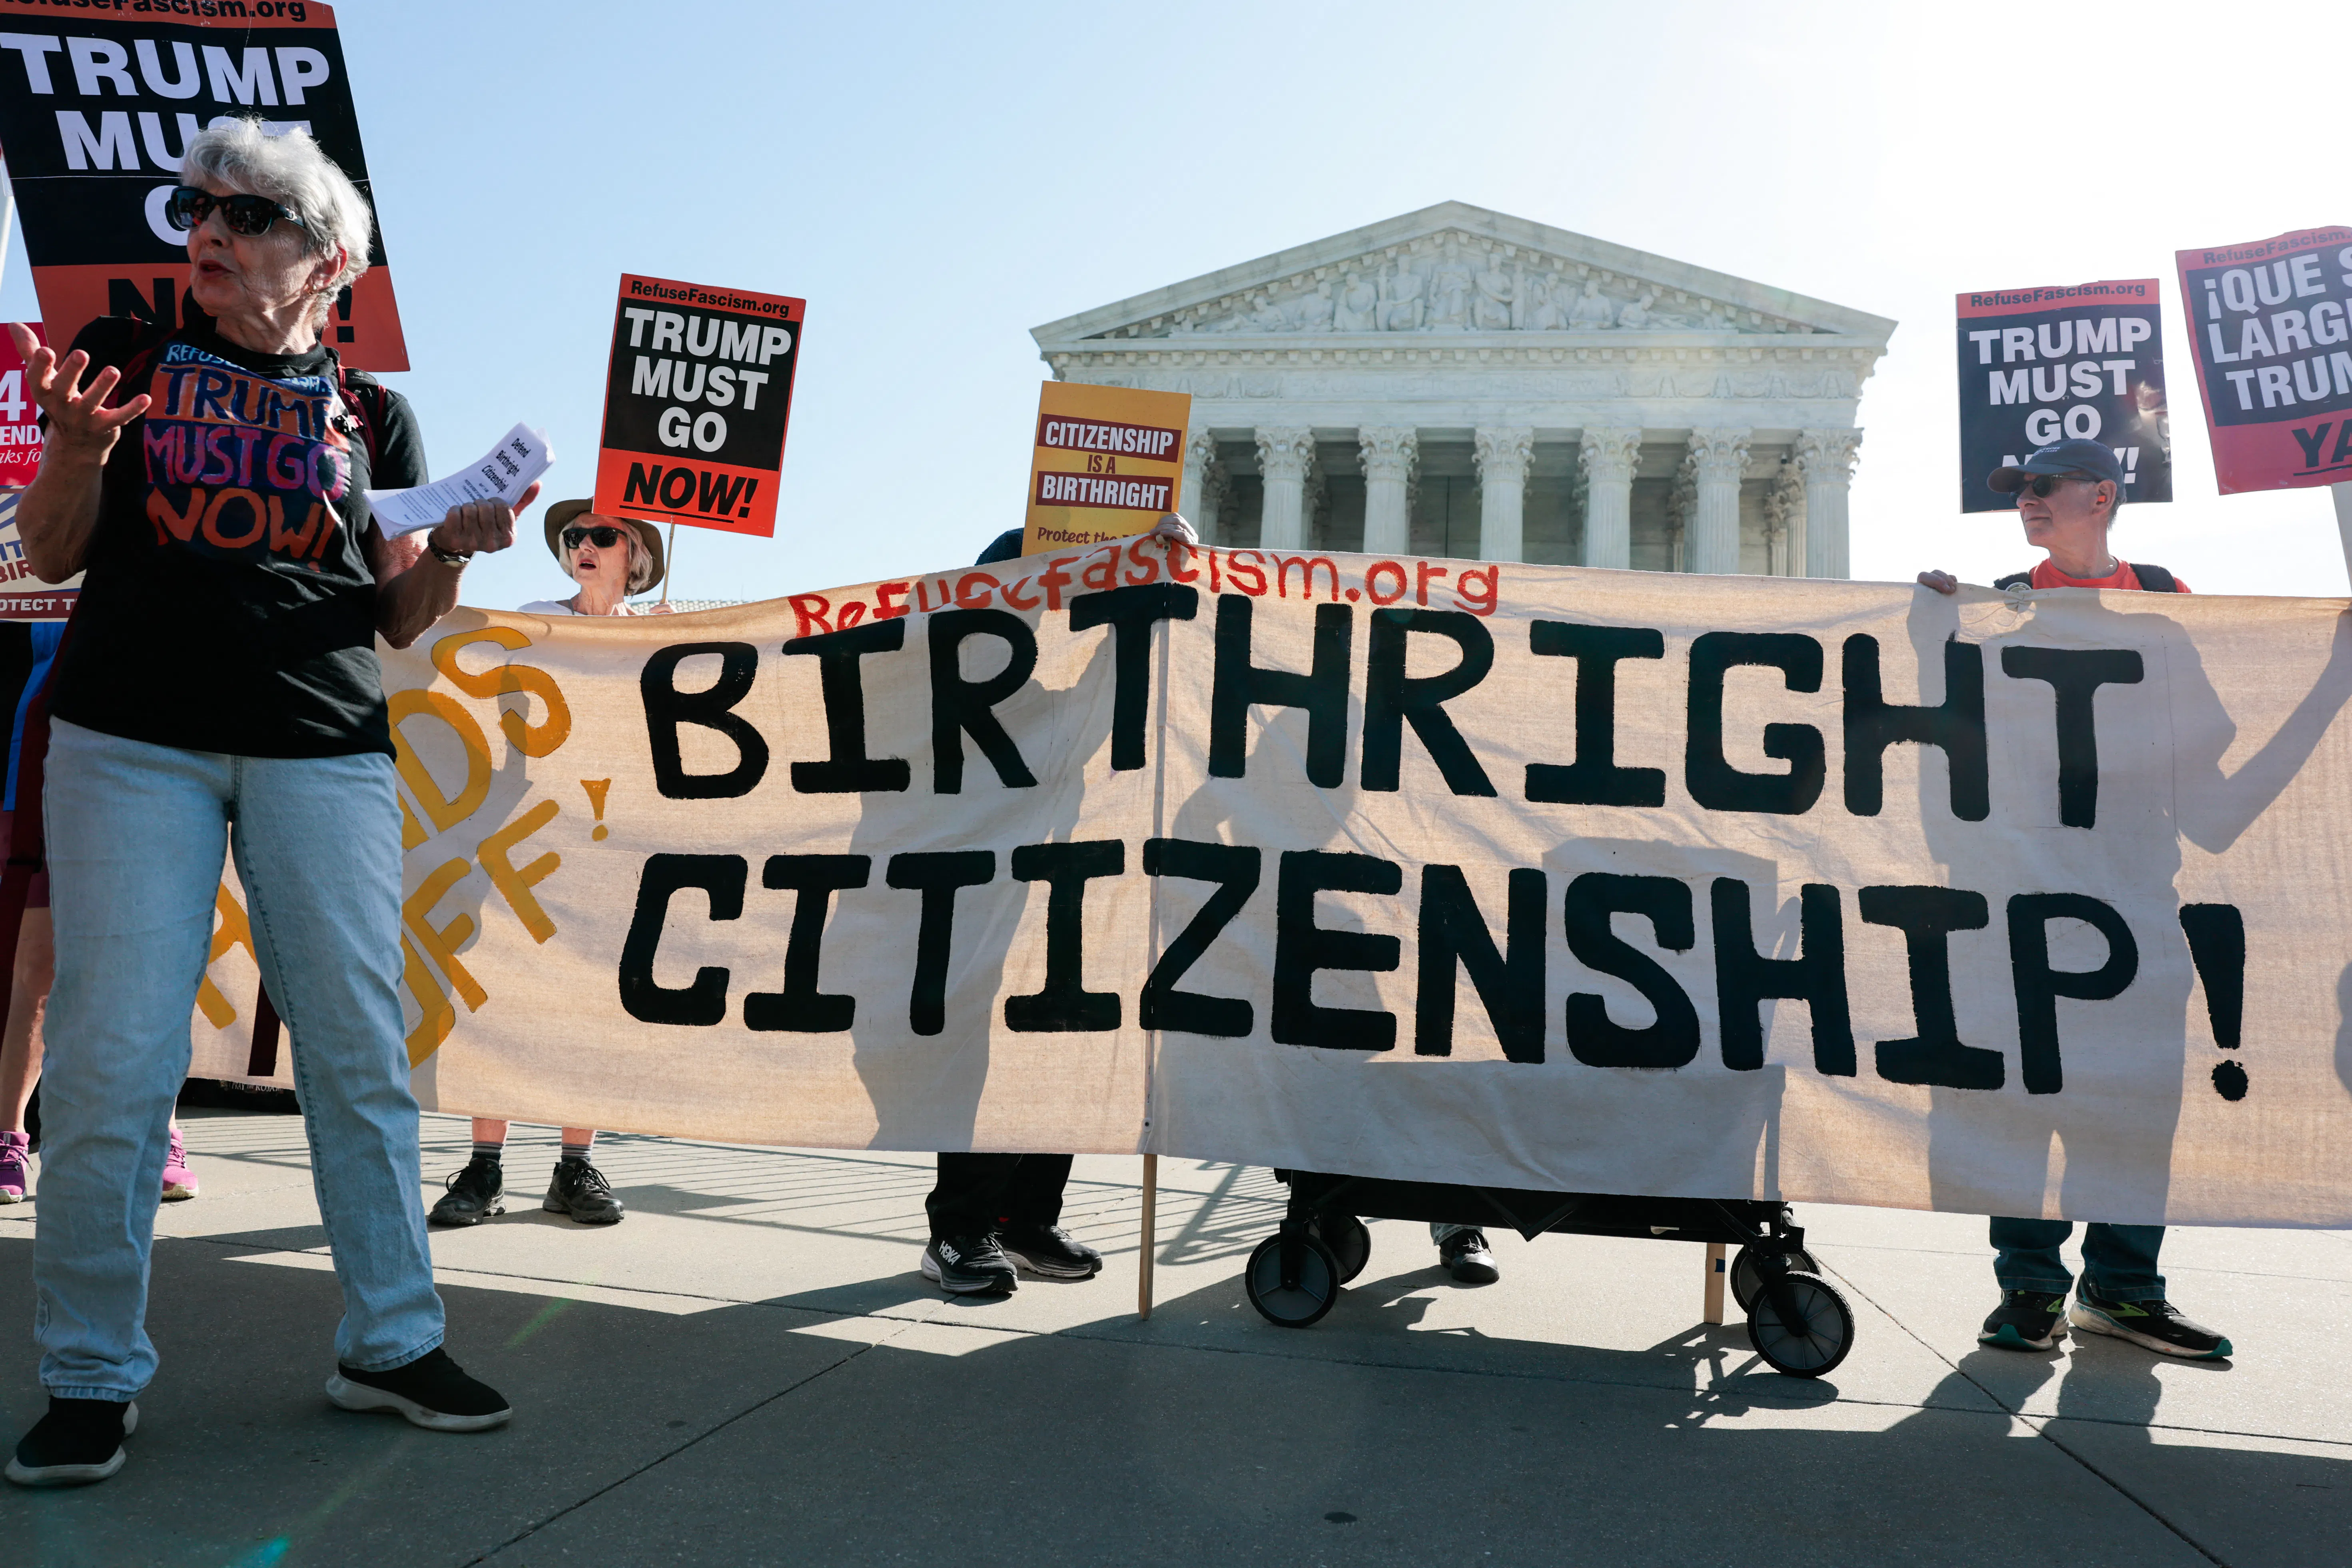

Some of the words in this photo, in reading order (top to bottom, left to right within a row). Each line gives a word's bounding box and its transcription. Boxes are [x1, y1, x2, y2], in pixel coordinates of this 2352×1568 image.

[1, 32, 329, 106] TRUMP
[55, 110, 313, 172] MU
[2203, 230, 2352, 265] RefuseFascism.
[631, 280, 790, 317] RefuseFascism.org
[1971, 284, 2145, 307] RefuseFascism.org
[2204, 253, 2326, 319] ¡QUE
[625, 307, 792, 365] TRUMP
[1969, 317, 2151, 364] TRUMP
[2208, 297, 2352, 363] LARG
[631, 355, 769, 411] MUST
[1989, 359, 2136, 405] MUST
[511, 438, 531, 458] Defend
[658, 406, 727, 453] GO
[1045, 421, 1173, 455] CITIZENSHIP
[2025, 405, 2101, 446] GO
[144, 424, 261, 486] MUST
[267, 435, 347, 502] GO
[482, 465, 509, 494] Citizenship!
[496, 450, 520, 477] Birthright
[1087, 455, 1102, 473] IS
[1105, 457, 1116, 474] A
[623, 462, 759, 519] NOW!
[1042, 475, 1169, 509] BIRTHRIGHT
[146, 487, 336, 573] NOW!
[1037, 527, 1090, 544] Protect
[639, 582, 2145, 830] BIRTHRIGHT
[618, 838, 2250, 1102] CITIZENSHIP!
[939, 1240, 961, 1266] HOKA
